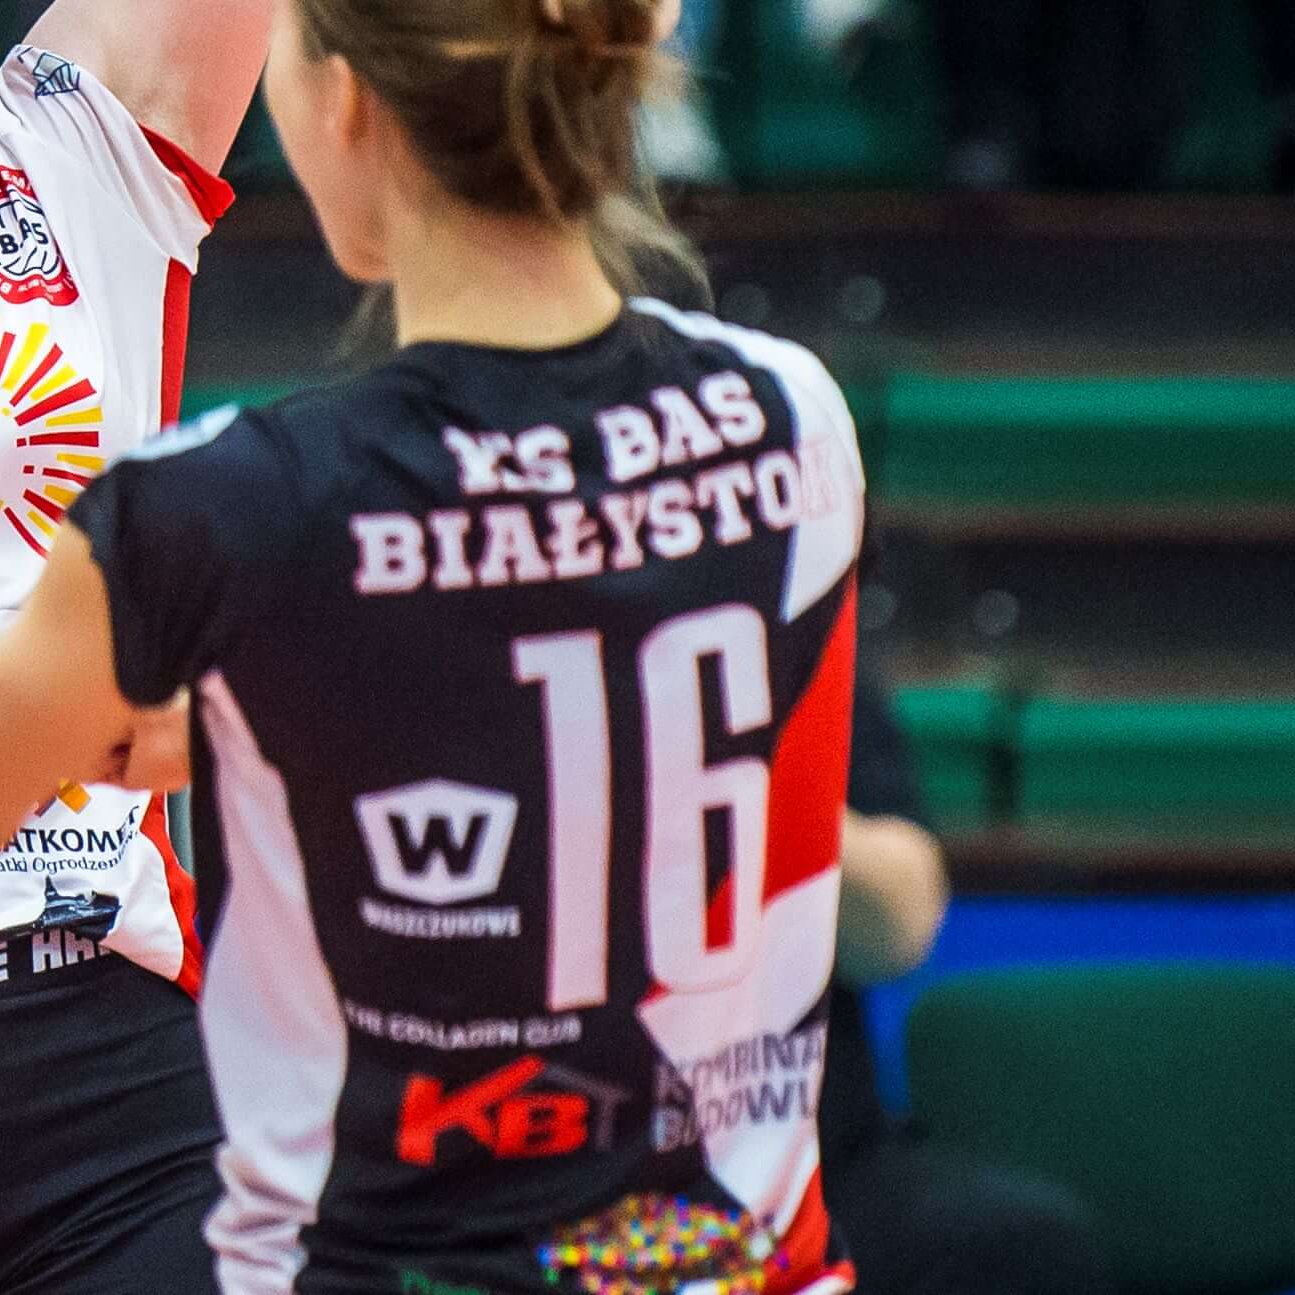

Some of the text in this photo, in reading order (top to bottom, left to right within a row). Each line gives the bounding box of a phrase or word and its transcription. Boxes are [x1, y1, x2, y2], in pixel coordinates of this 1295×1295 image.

[596, 371, 767, 483] BAS
[350, 436, 838, 595] BIAŁYSTOK
[511, 601, 774, 1012] 16
